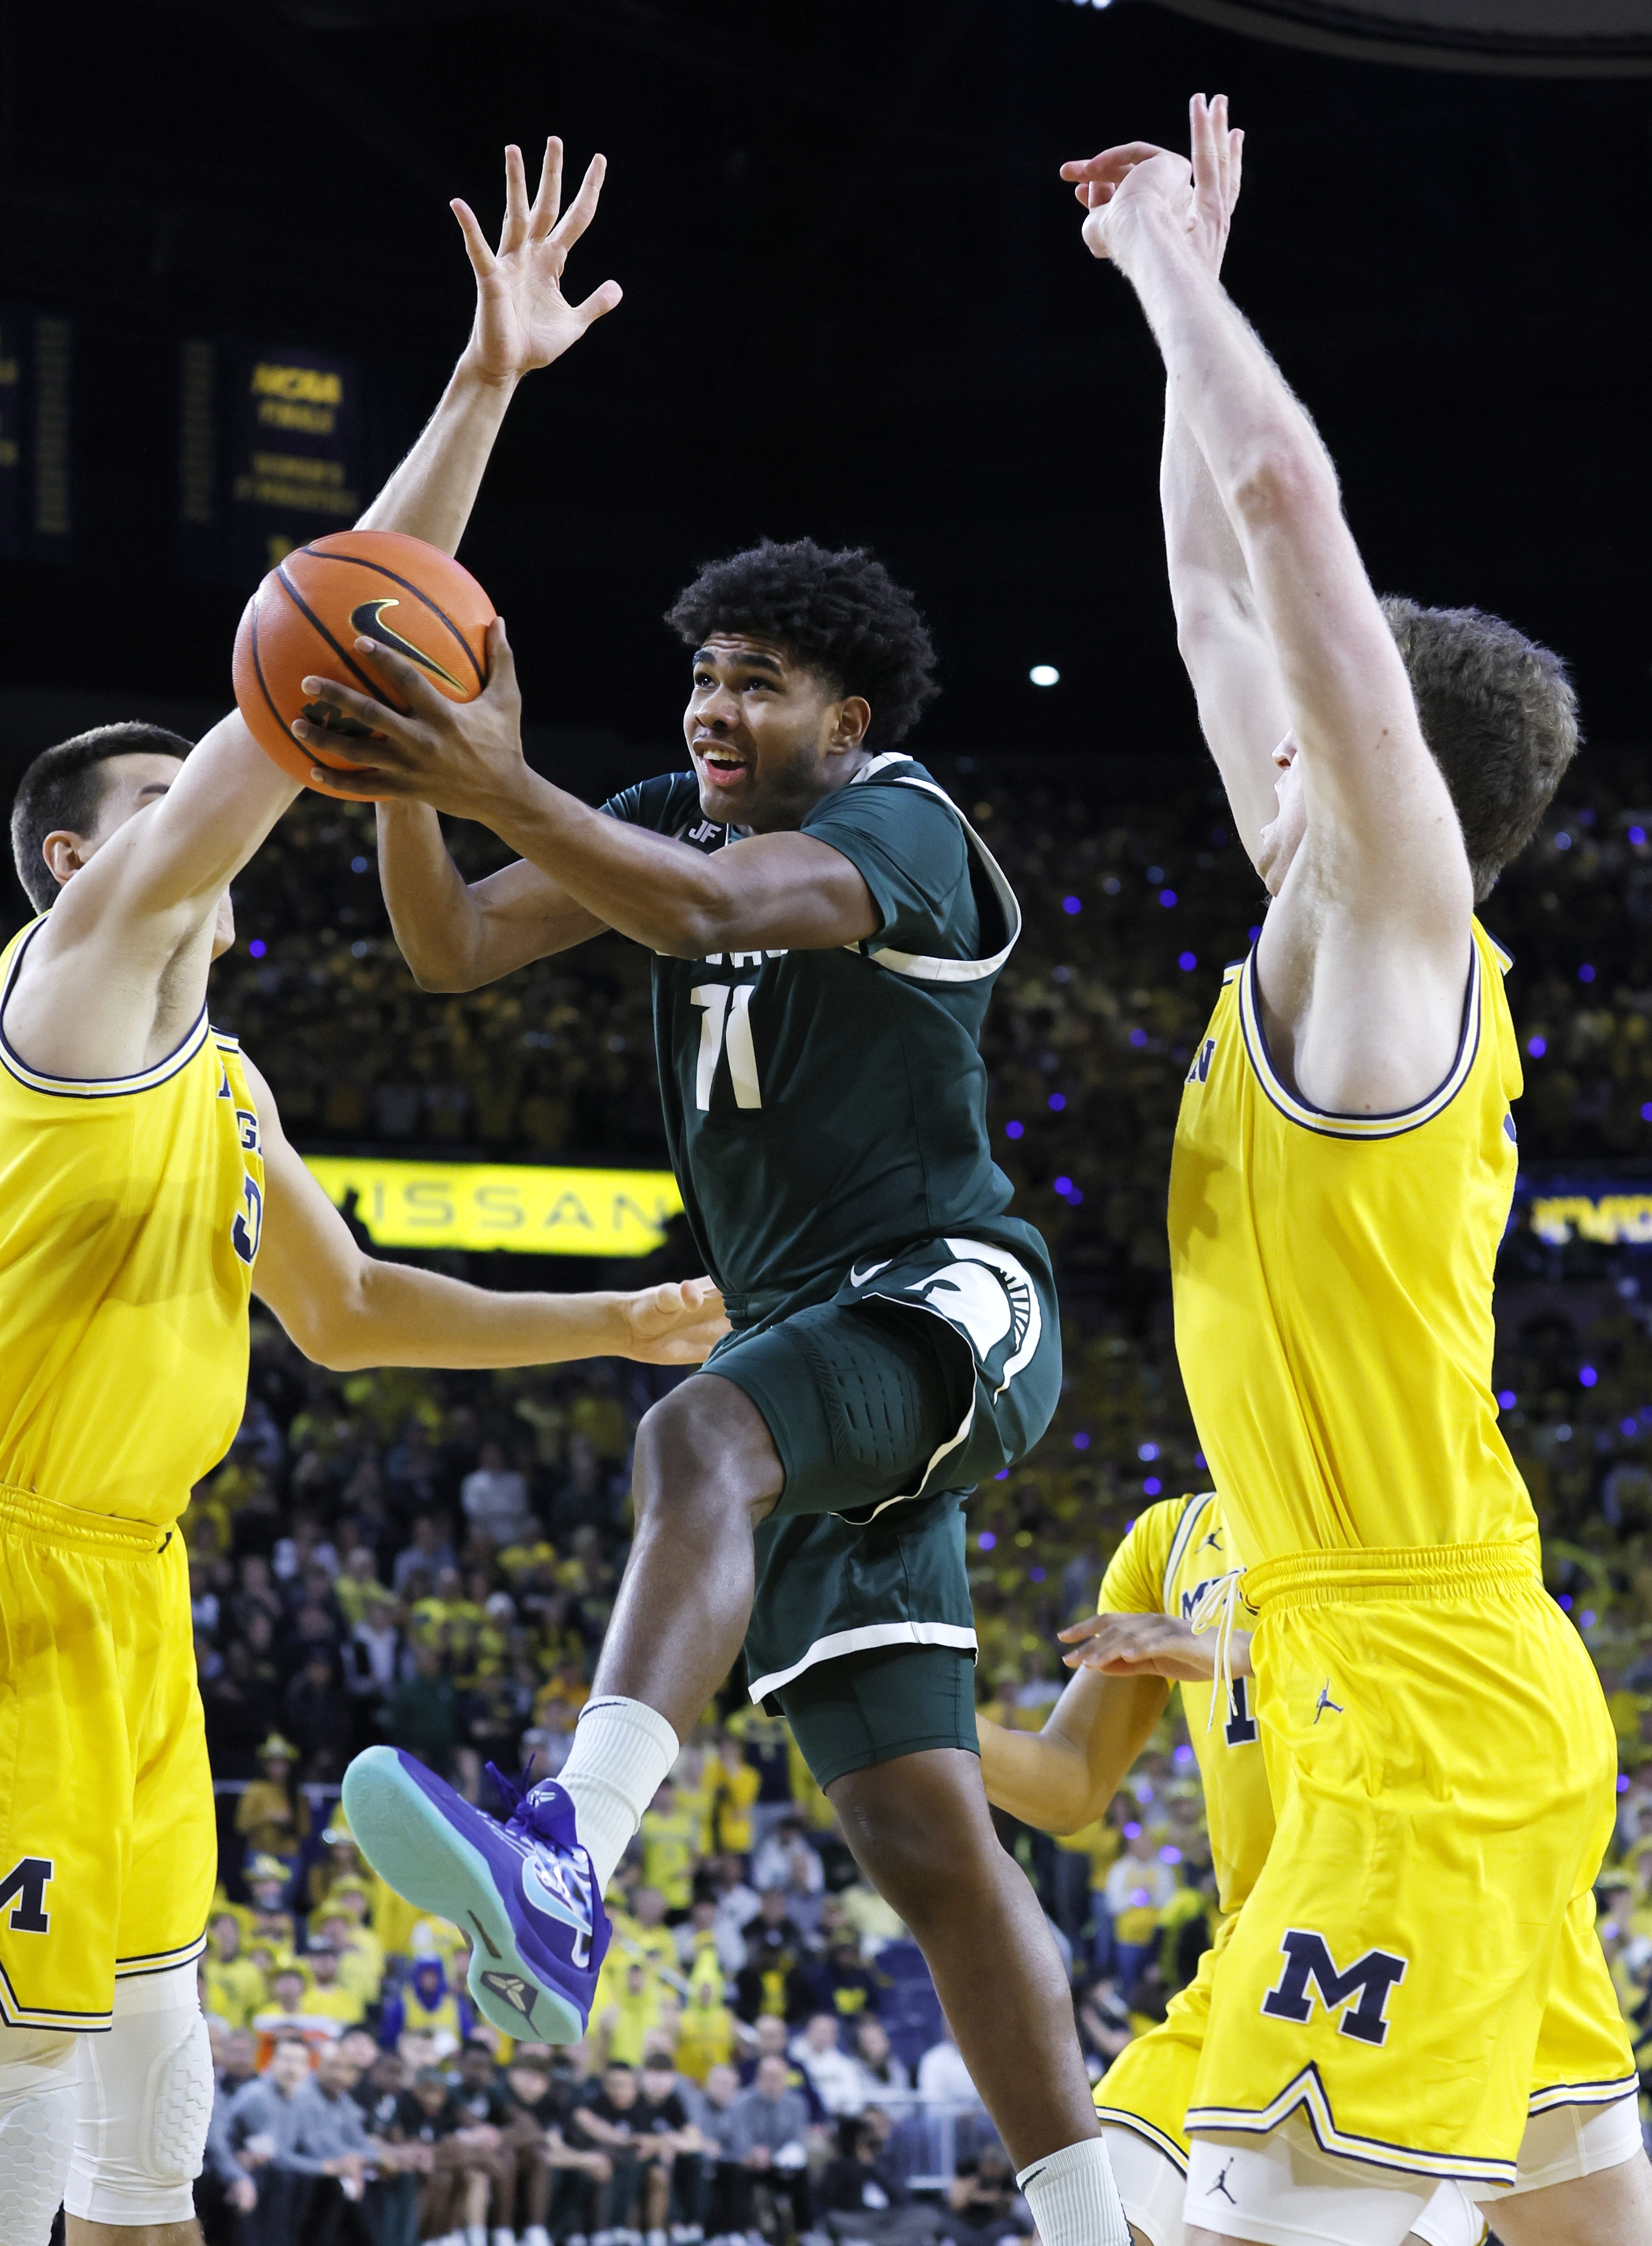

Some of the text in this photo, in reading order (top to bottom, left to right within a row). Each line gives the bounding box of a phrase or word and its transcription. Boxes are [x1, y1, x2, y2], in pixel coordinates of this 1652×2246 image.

[688, 819, 722, 843] JF
[690, 983, 762, 1112] 11
[343, 1179, 666, 1232] ISSAN
[1260, 1928, 1409, 2048] M
